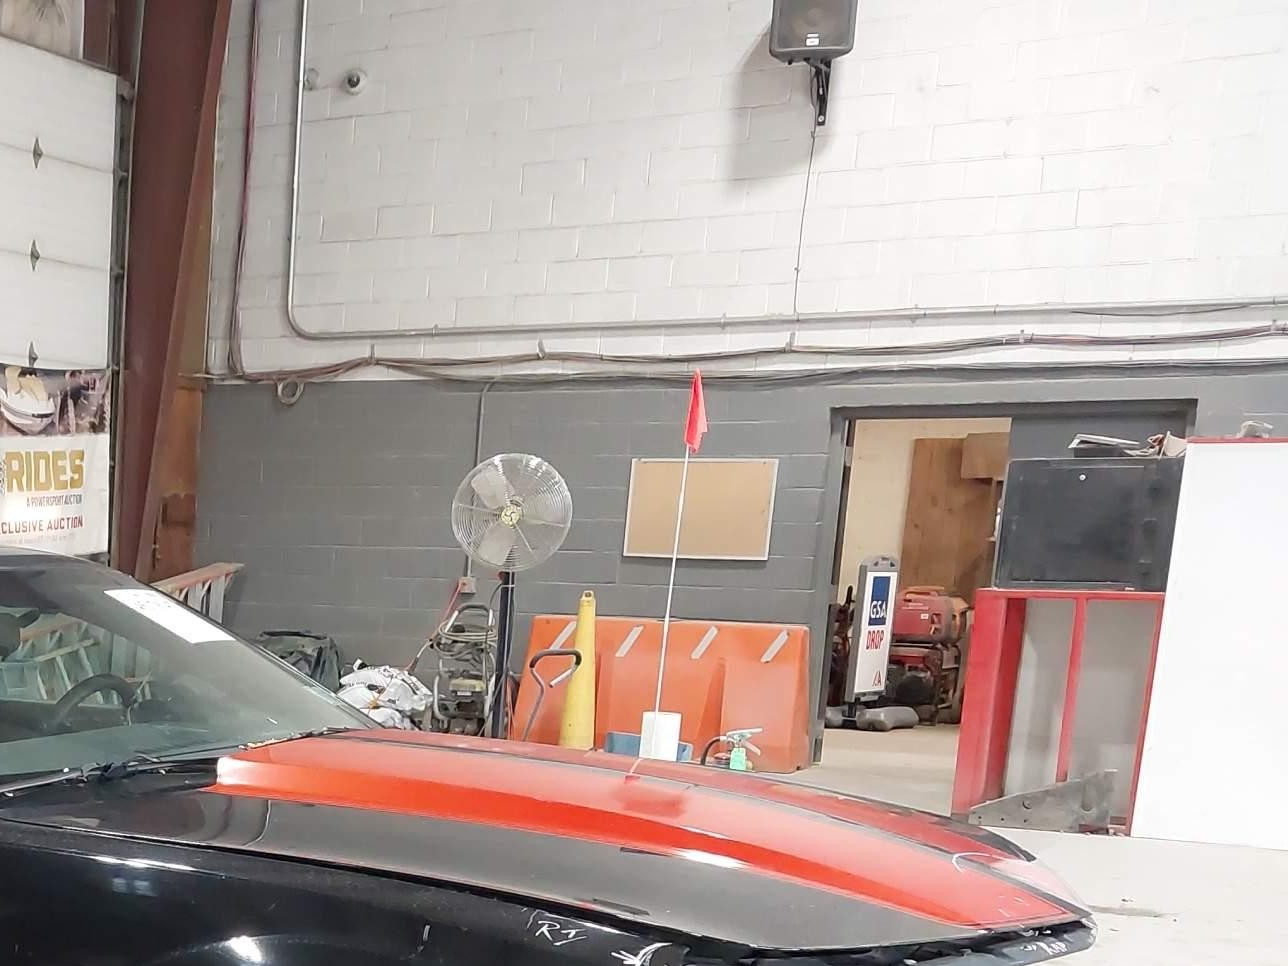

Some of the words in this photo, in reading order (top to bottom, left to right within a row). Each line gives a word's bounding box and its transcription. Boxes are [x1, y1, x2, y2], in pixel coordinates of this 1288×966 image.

[5, 449, 85, 492] RIDES
[64, 494, 83, 506] AUCTION
[47, 515, 84, 531] AUCTION
[870, 601, 887, 619] GSA
[866, 630, 884, 650] DROP
